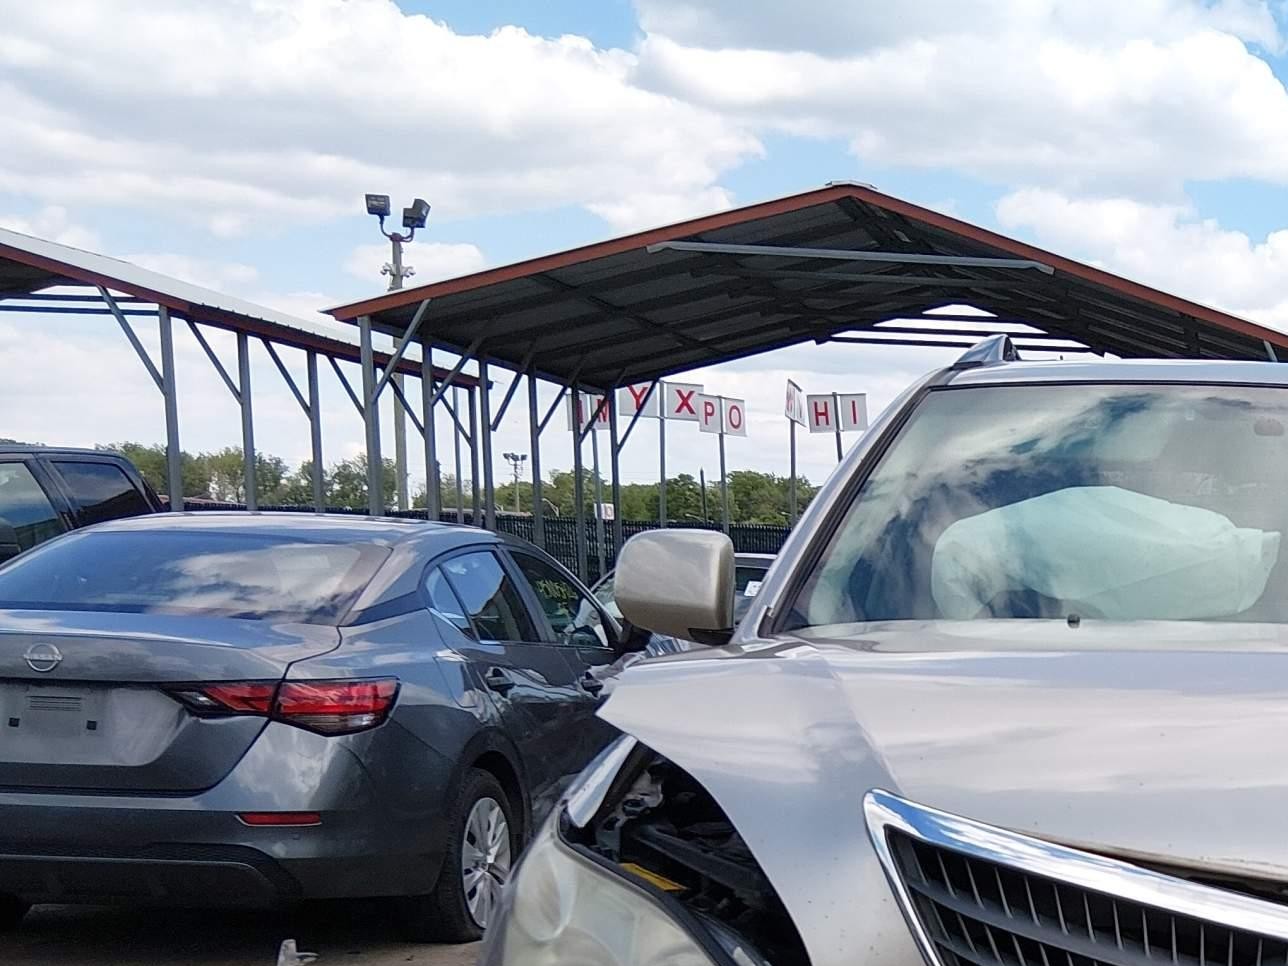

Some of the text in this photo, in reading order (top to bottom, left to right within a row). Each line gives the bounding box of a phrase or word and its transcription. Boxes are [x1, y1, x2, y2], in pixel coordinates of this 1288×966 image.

[627, 384, 696, 415] Y X
[814, 400, 857, 426] H I
[704, 401, 742, 429] P O
